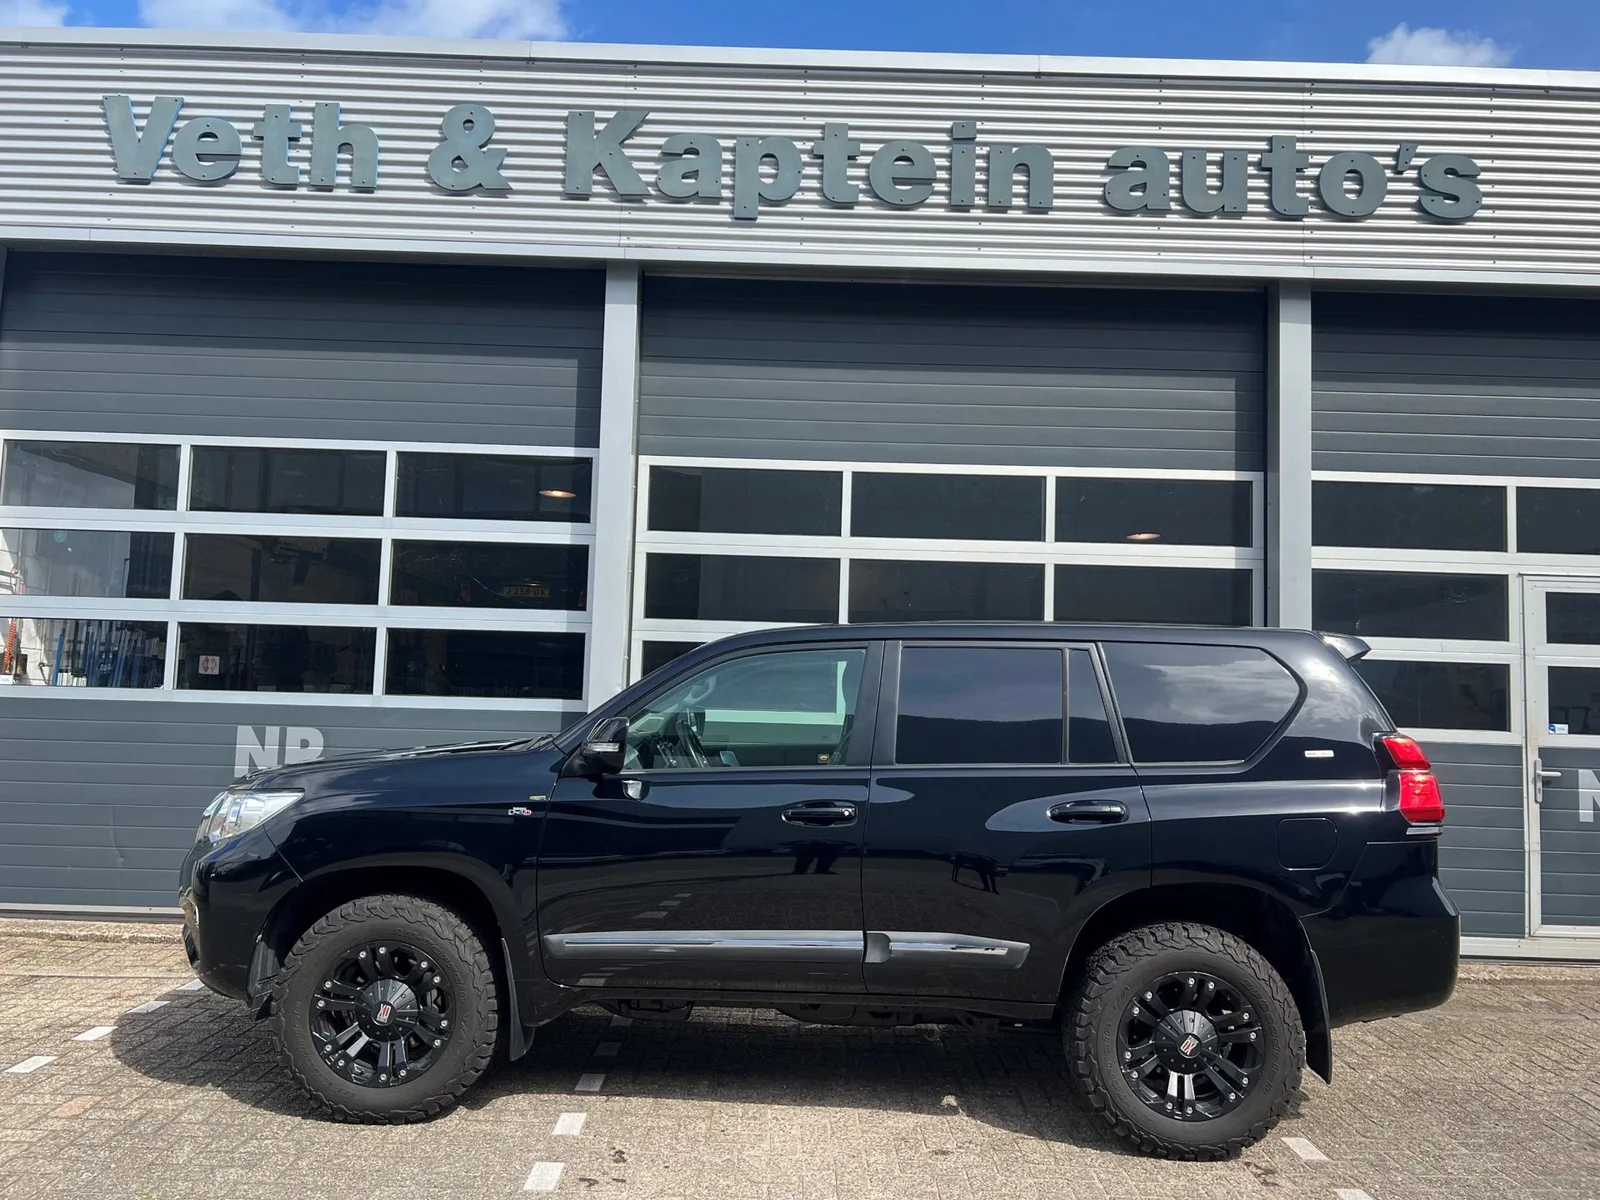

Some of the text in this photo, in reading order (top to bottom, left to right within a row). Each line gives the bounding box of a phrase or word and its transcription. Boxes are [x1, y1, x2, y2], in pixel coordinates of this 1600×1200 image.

[102, 94, 1482, 221] Veth & Kaptein auto's
